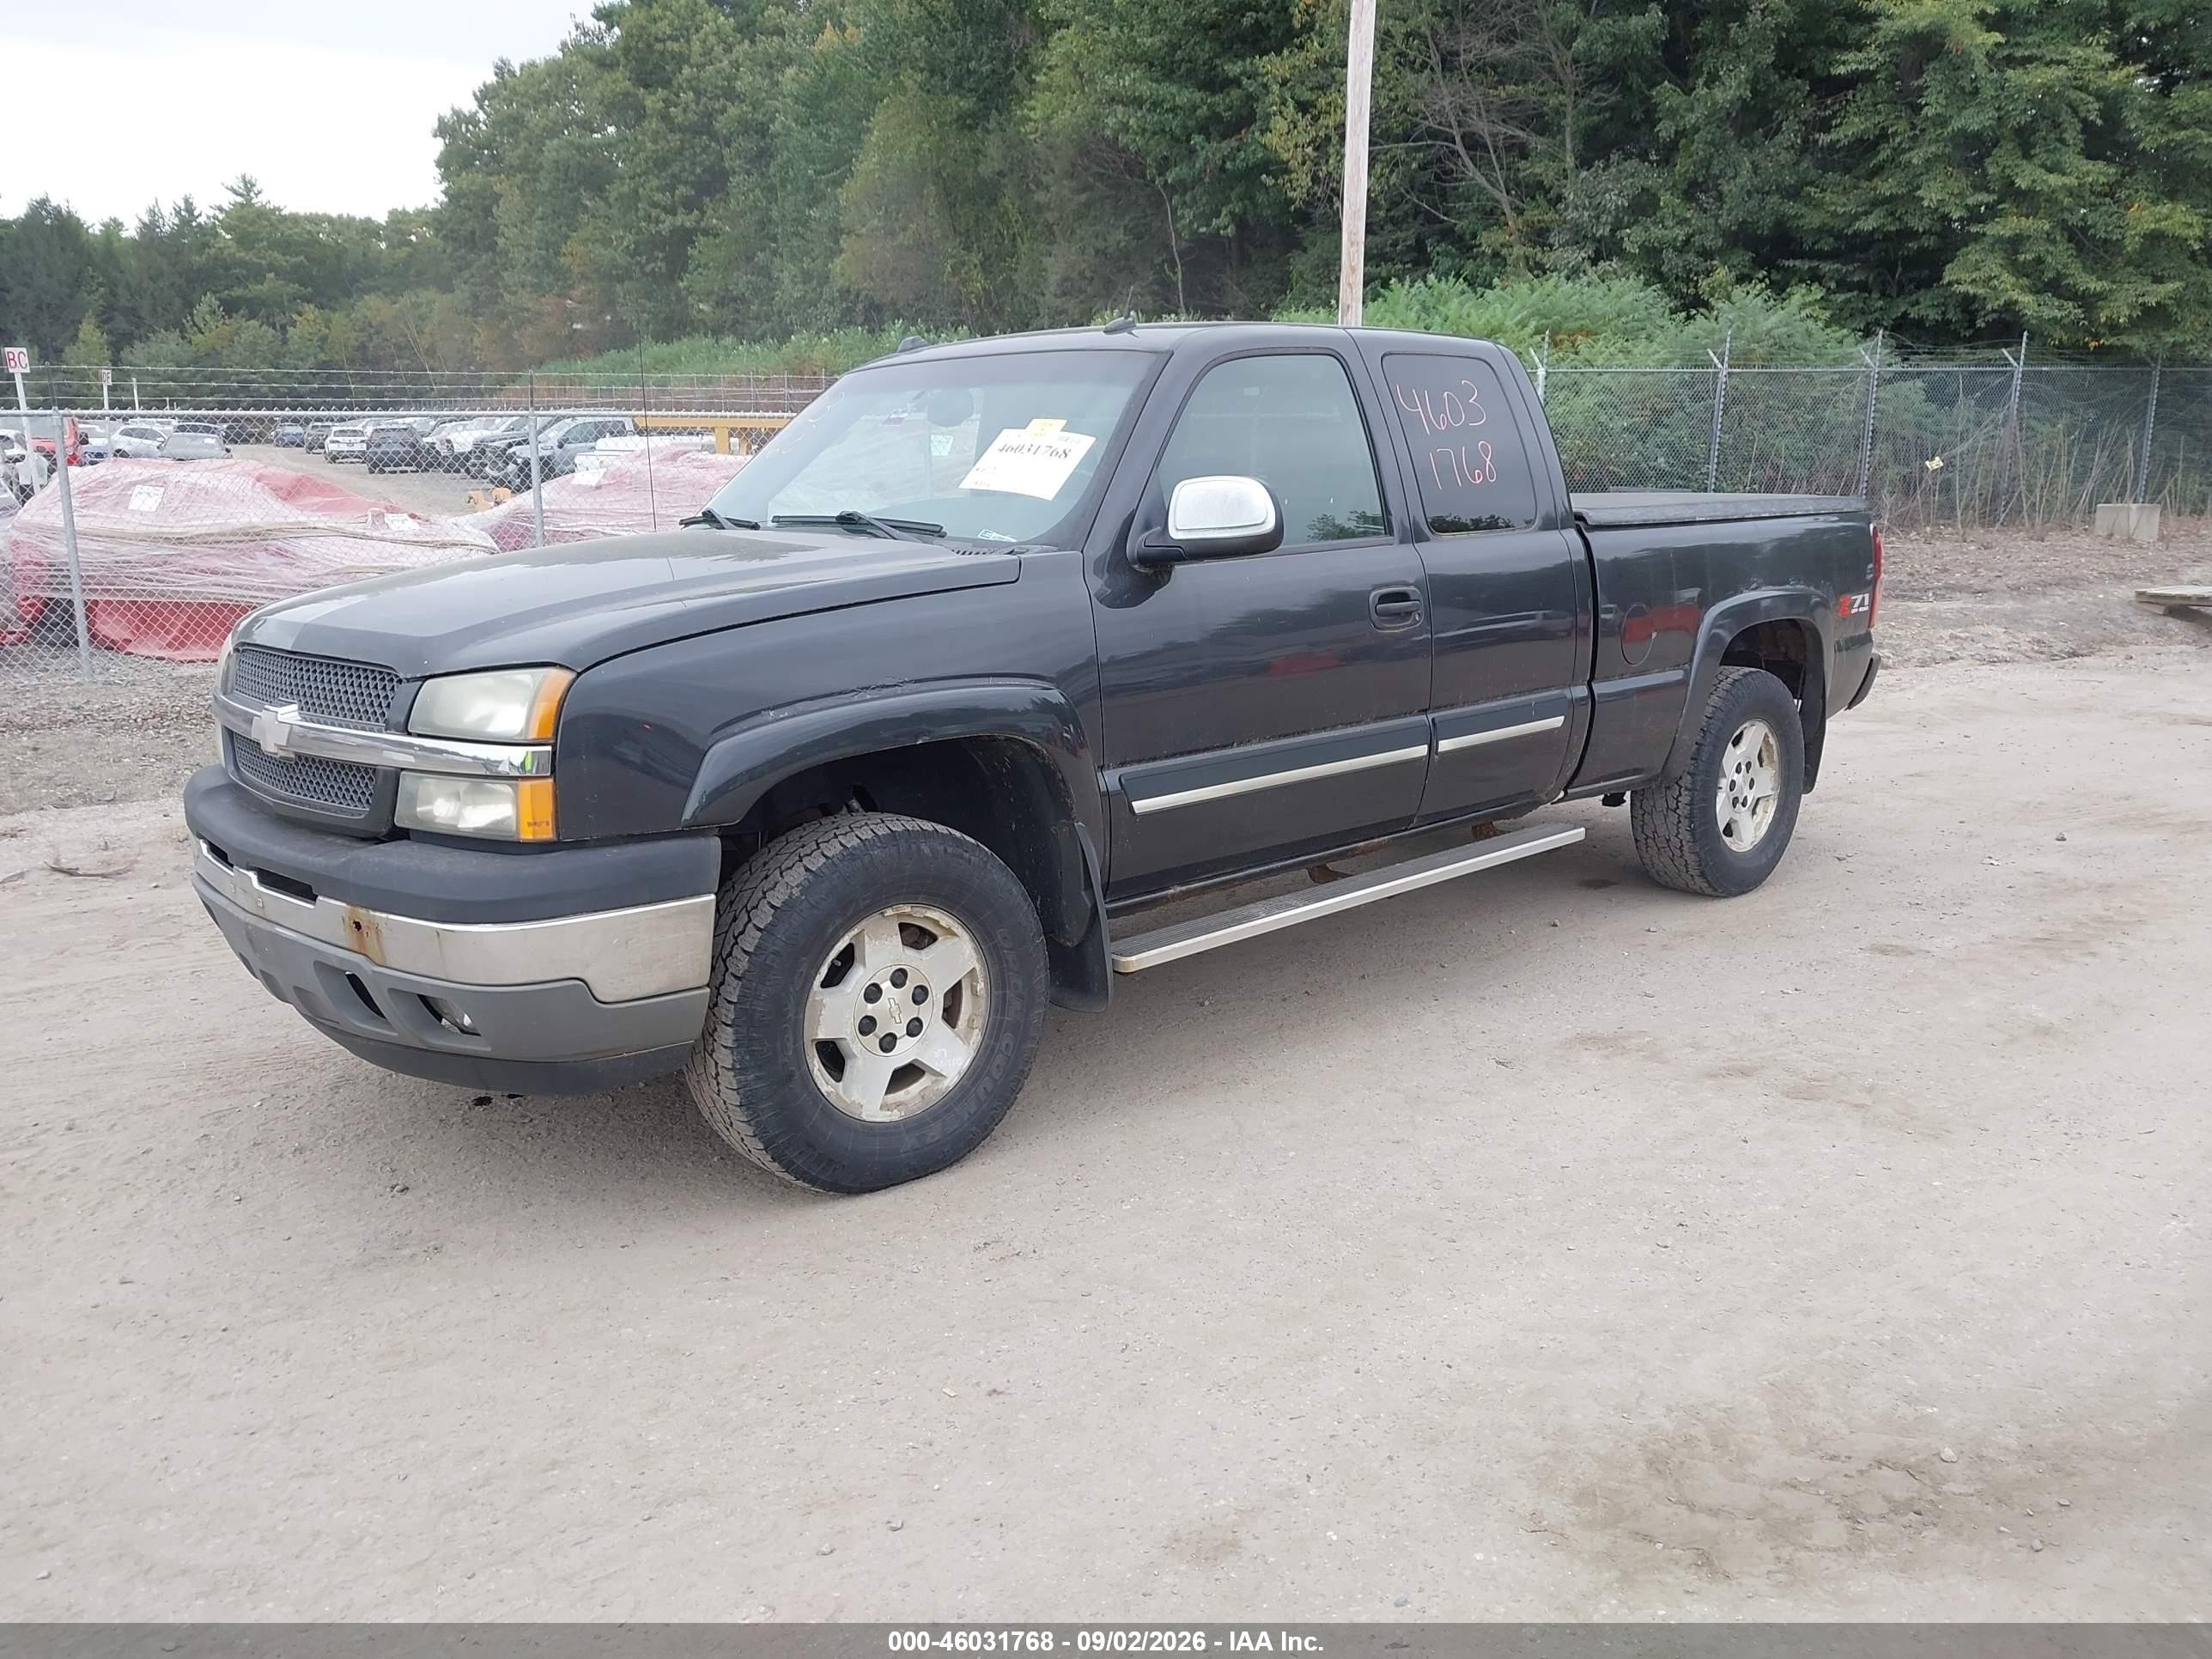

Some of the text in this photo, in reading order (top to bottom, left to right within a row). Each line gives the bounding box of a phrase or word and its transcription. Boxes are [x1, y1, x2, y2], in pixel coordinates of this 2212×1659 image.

[6, 350, 28, 370] BC
[102, 371, 111, 384] DF
[1396, 380, 1486, 435] 4603
[997, 443, 1072, 460] 46031768
[1429, 441, 1498, 490] 1768
